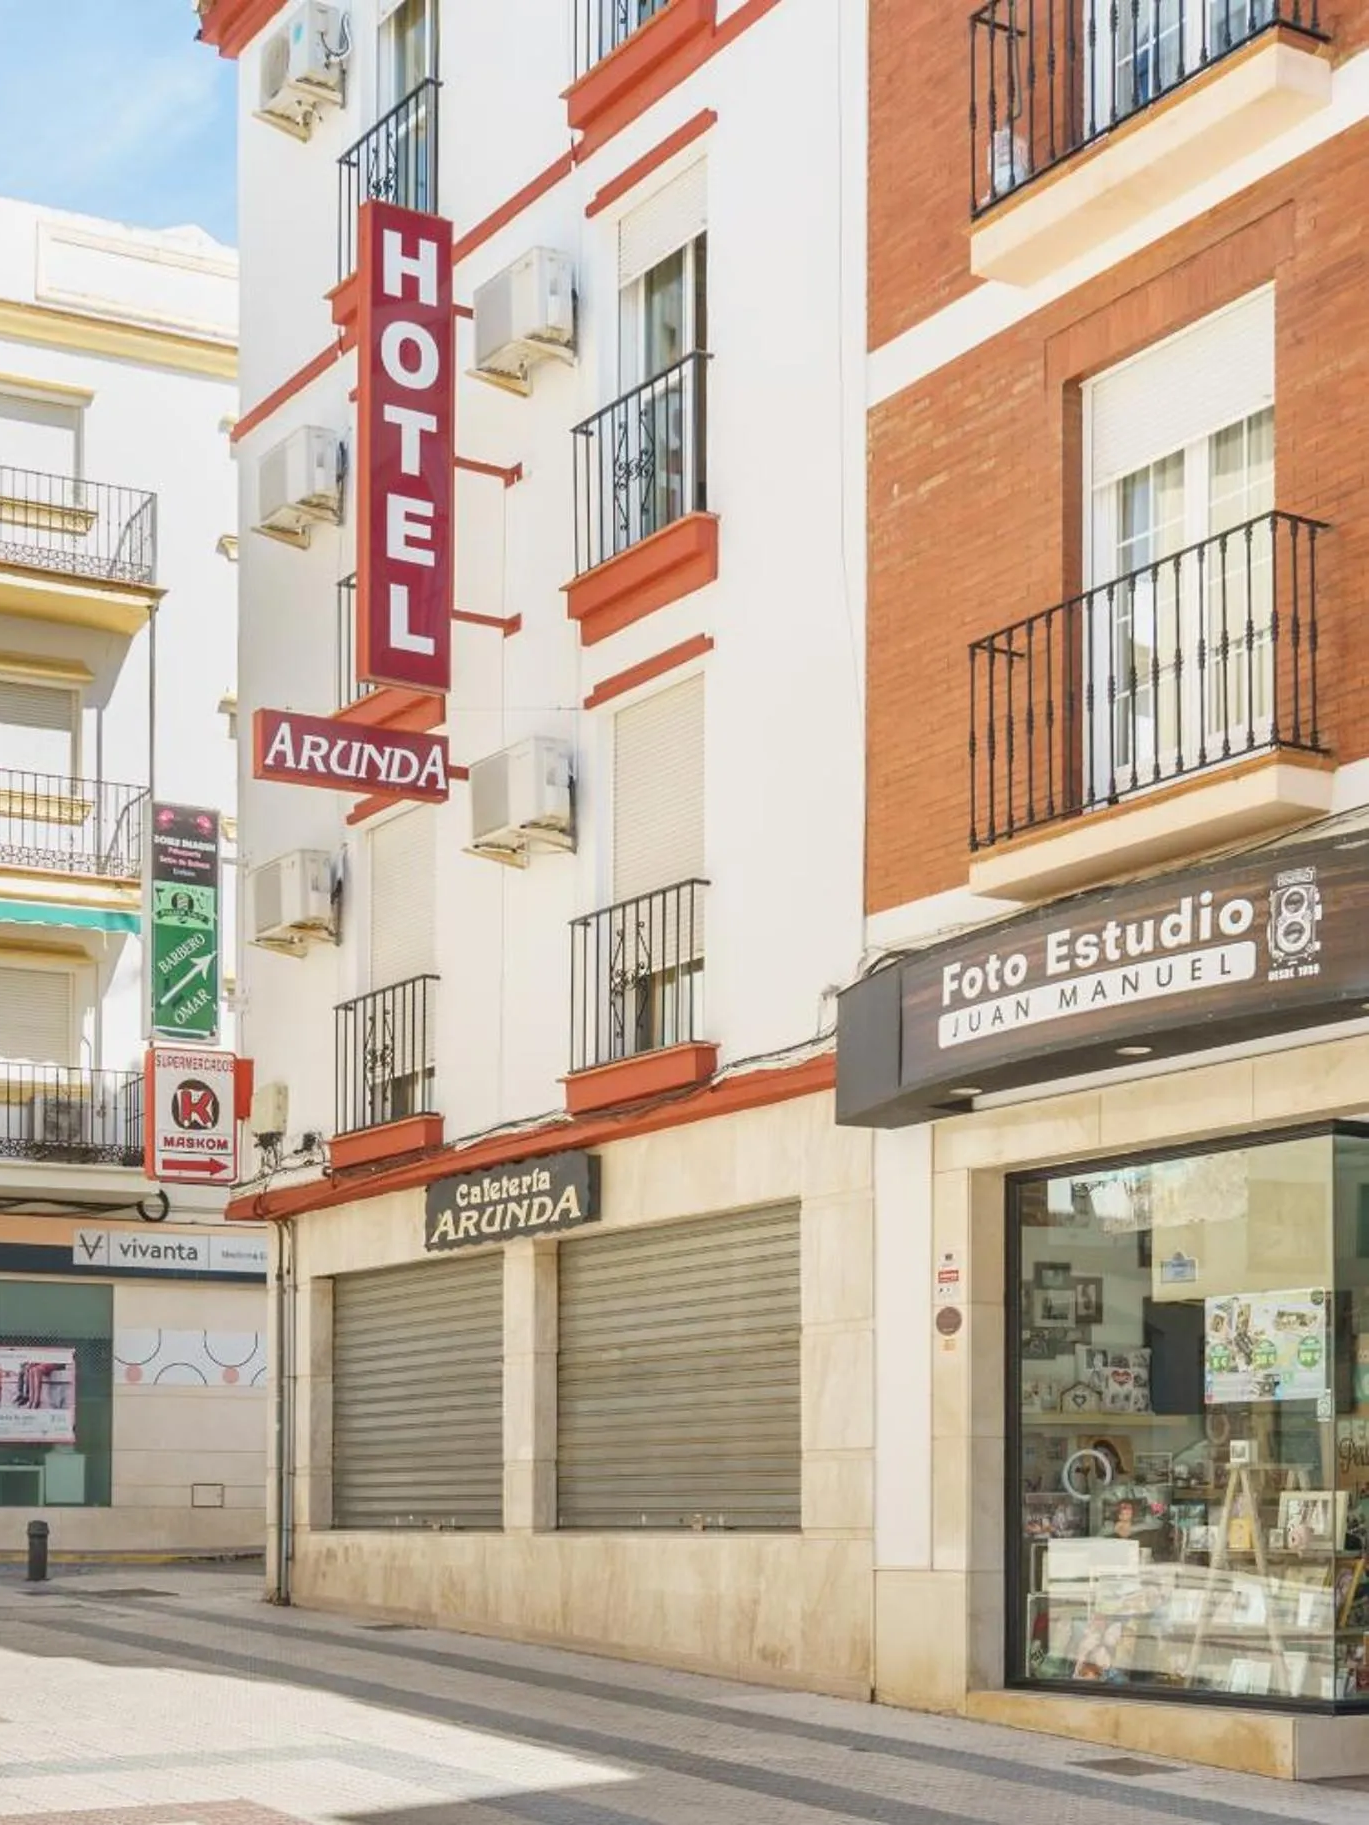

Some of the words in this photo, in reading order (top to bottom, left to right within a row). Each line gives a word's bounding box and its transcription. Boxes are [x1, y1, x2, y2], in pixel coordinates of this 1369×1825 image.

[381, 229, 439, 655] HOTEL
[264, 722, 448, 789] ARUNDA
[158, 933, 206, 974] BARBERO
[942, 952, 1028, 1006] Foto
[1046, 890, 1254, 975] Estudio
[174, 988, 212, 1025] OMAR
[951, 997, 1029, 1038] JUAN
[1059, 953, 1231, 1009] MANUEL
[156, 1054, 234, 1072] SUPERMERCADOS
[178, 1088, 214, 1127] K
[163, 1136, 228, 1150] MASKOM
[431, 1185, 581, 1243] ARUNDA
[119, 1238, 199, 1261] vivanta
